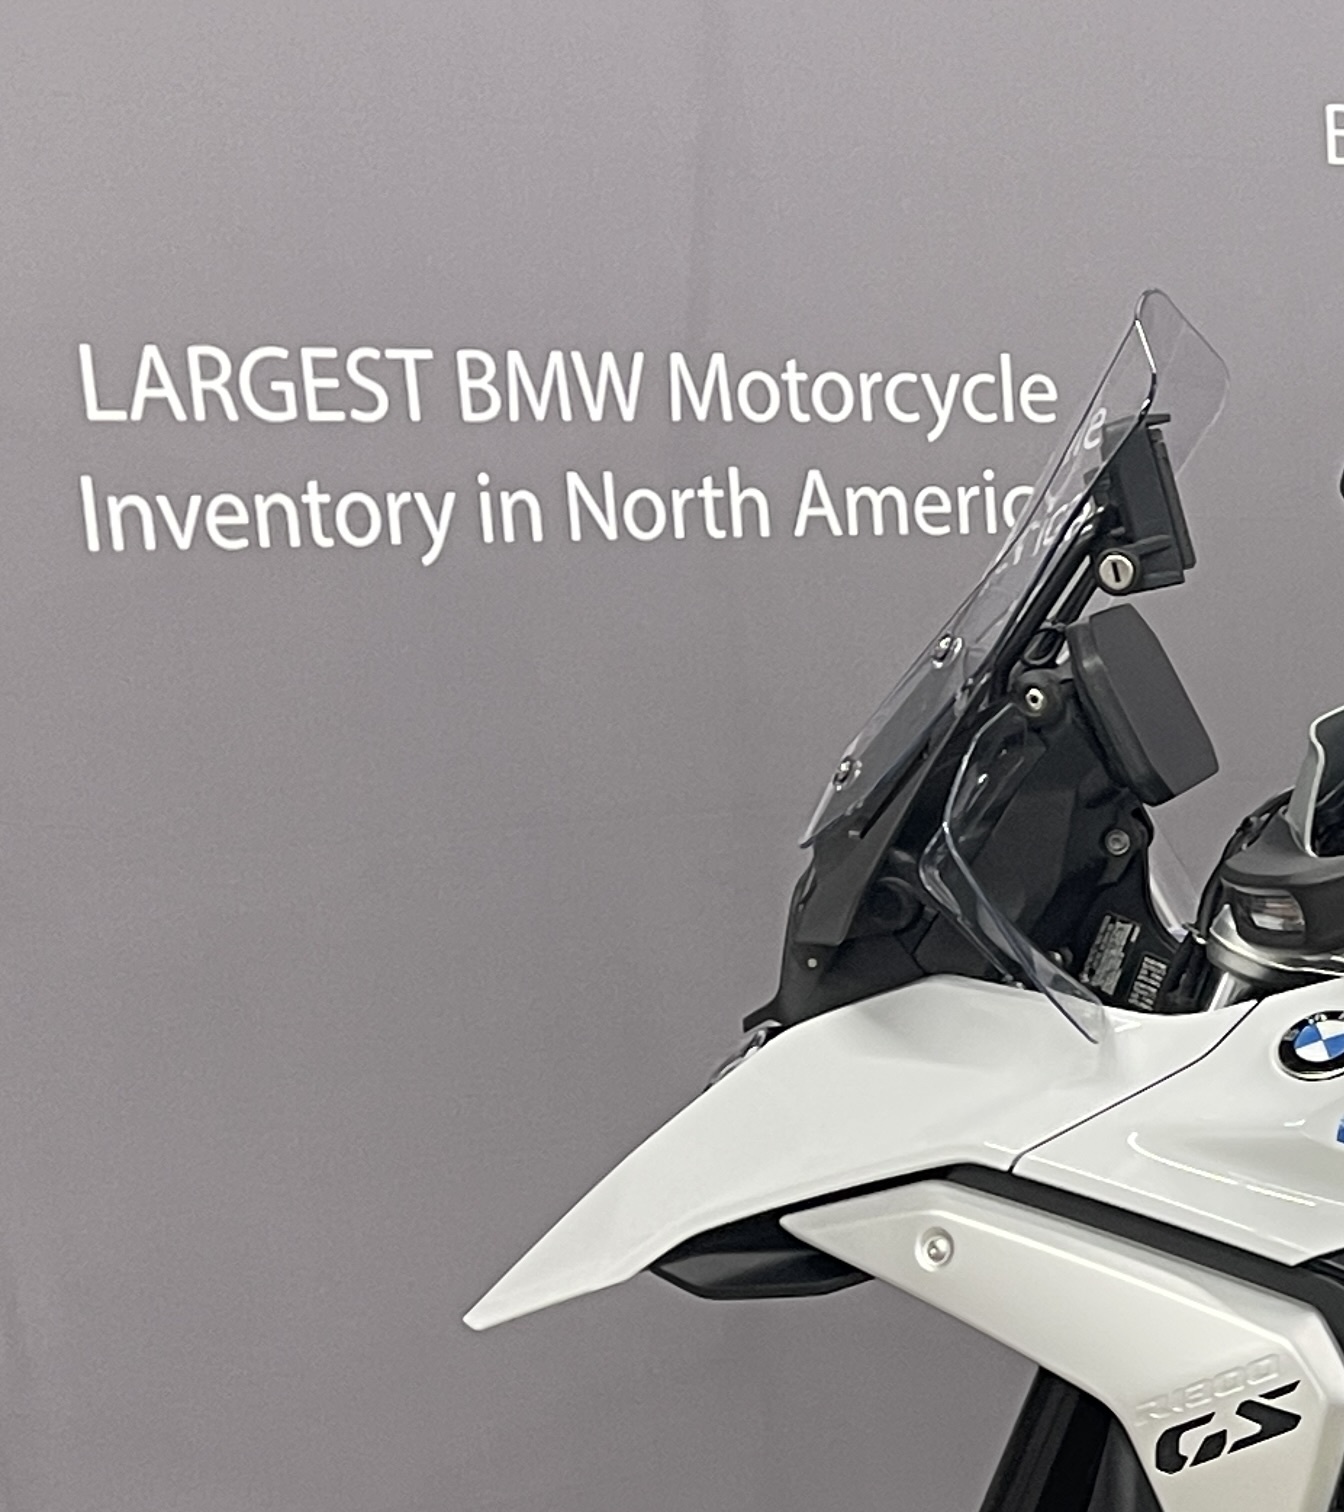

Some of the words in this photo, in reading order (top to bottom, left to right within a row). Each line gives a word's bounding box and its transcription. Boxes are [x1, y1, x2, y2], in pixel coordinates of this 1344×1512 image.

[78, 342, 435, 424] LARGEST
[456, 349, 645, 423] BMW
[669, 352, 1059, 444] Motorcycle
[79, 475, 457, 567] Inventory
[476, 471, 544, 544] in
[565, 466, 771, 543] North
[793, 468, 1040, 542] Americ
[1154, 1379, 1302, 1475] GS
